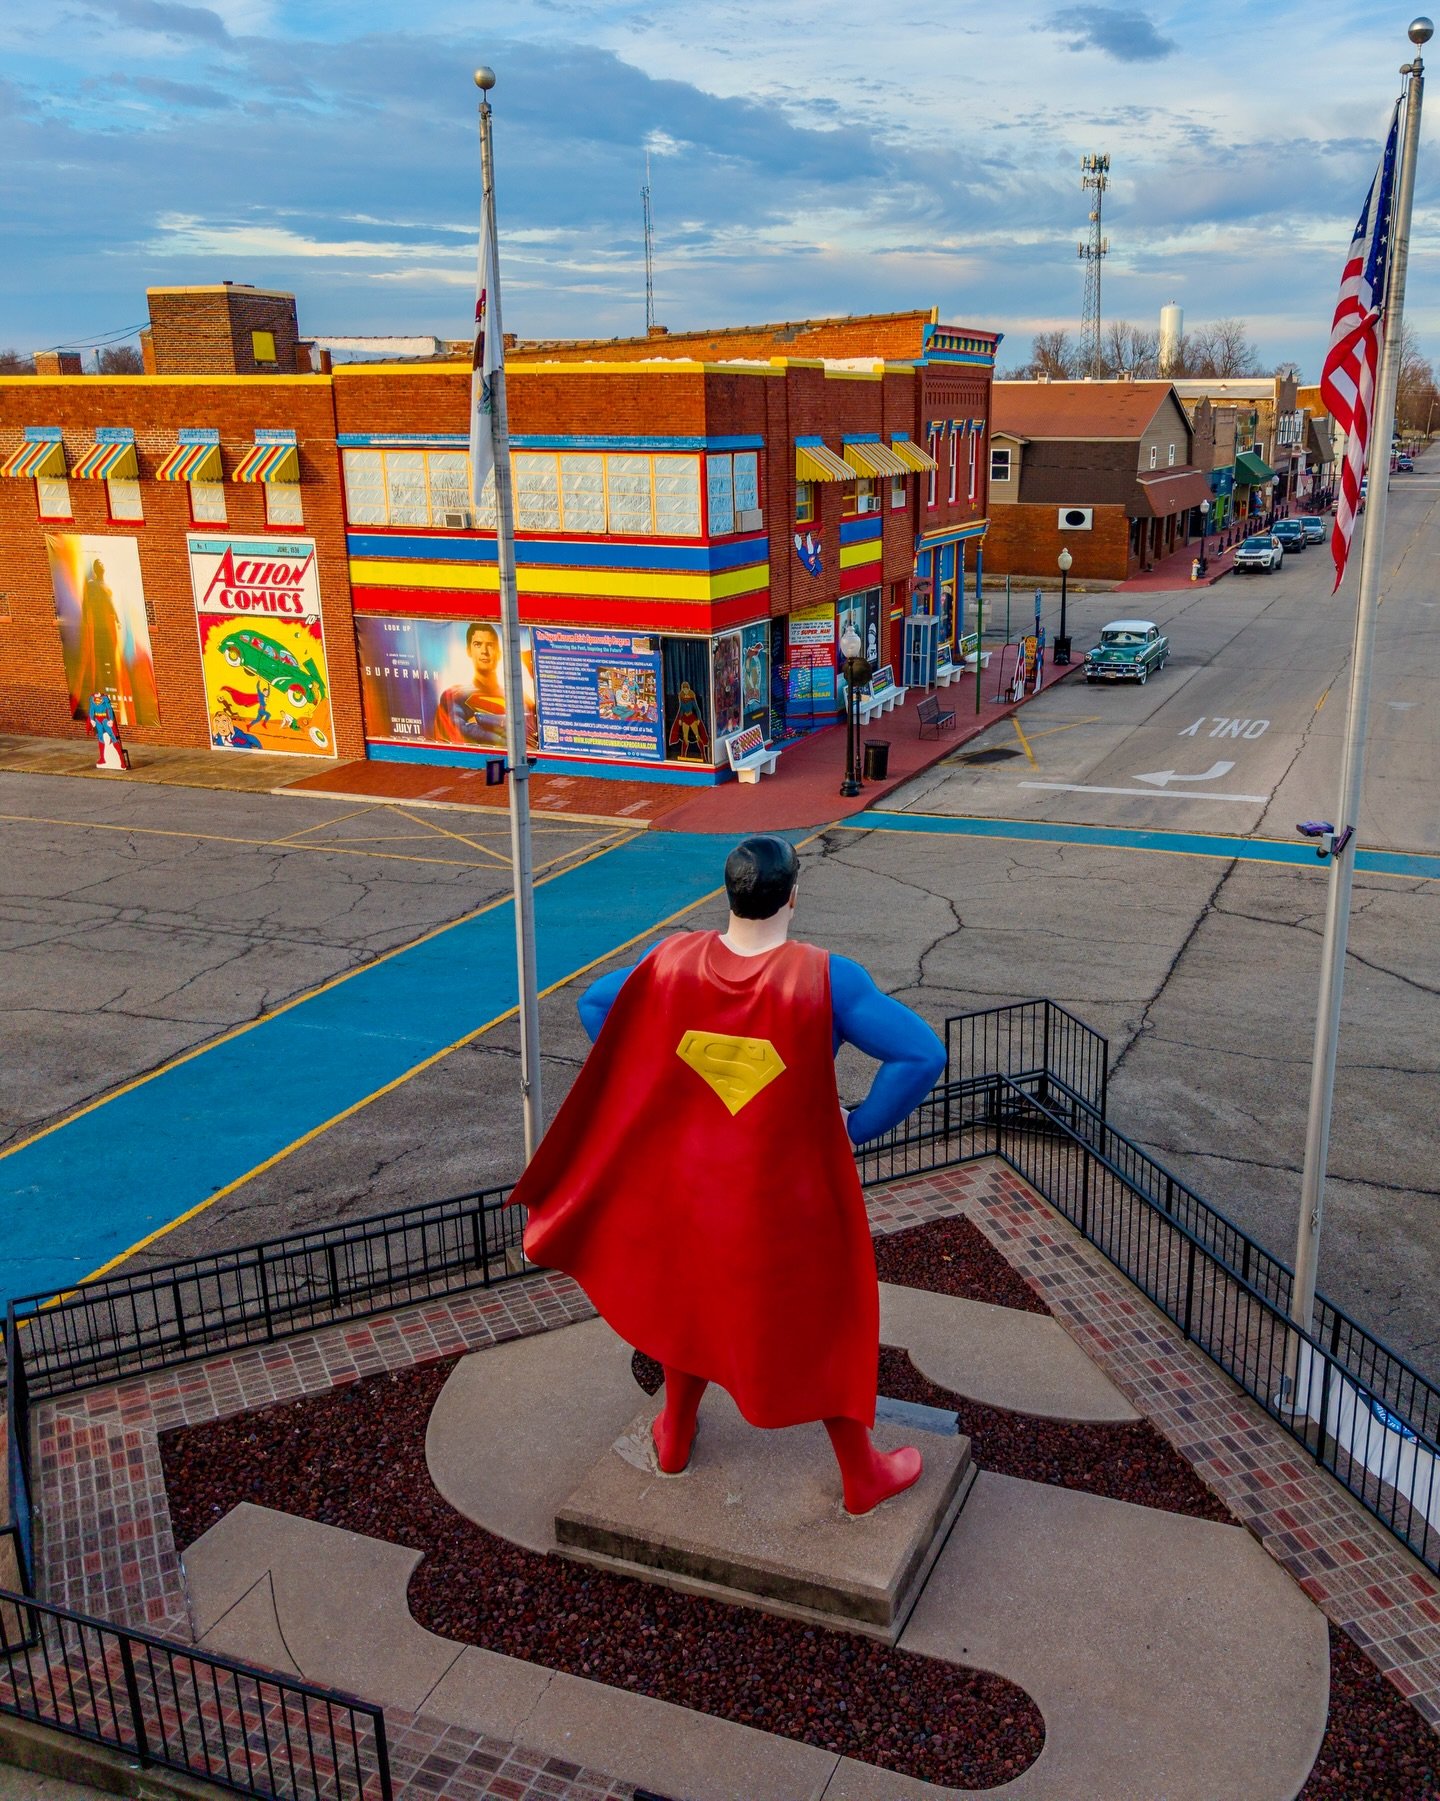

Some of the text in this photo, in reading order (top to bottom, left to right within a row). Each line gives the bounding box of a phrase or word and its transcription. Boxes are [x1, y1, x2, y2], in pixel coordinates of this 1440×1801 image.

[203, 543, 315, 605] ACTION
[219, 589, 304, 614] COMICS
[365, 666, 441, 680] SUPERMAN
[393, 723, 421, 735] JULY 11
[1178, 717, 1270, 739] ONLY
